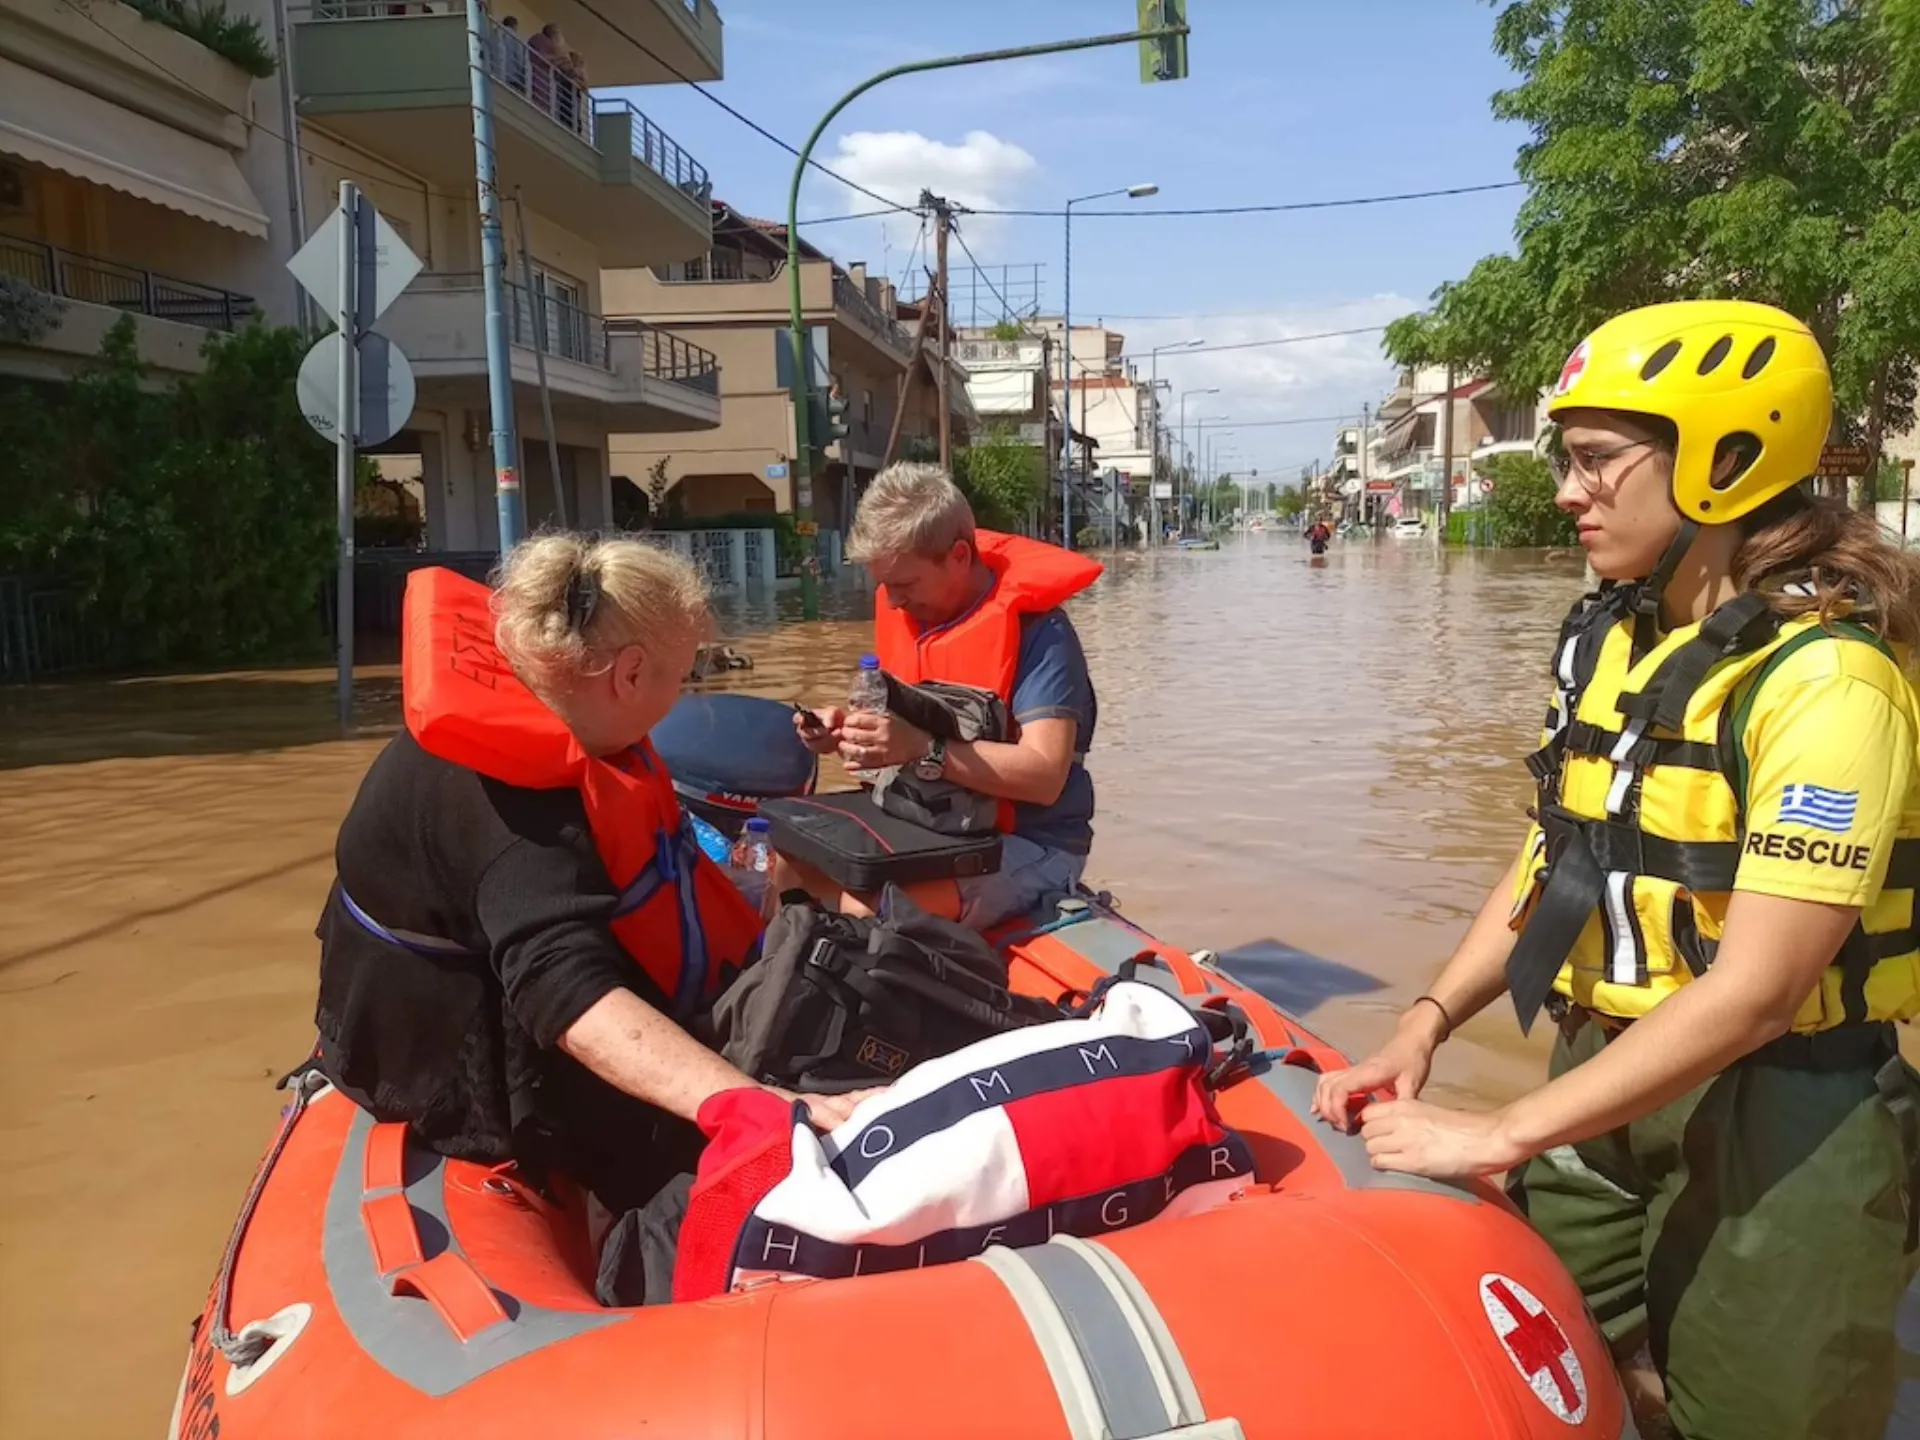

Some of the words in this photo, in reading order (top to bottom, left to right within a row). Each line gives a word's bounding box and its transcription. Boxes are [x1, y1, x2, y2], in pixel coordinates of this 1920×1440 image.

[722, 791, 767, 806] YAM
[1745, 832, 1870, 871] RESCUE
[860, 1033, 1195, 1159] OMMY
